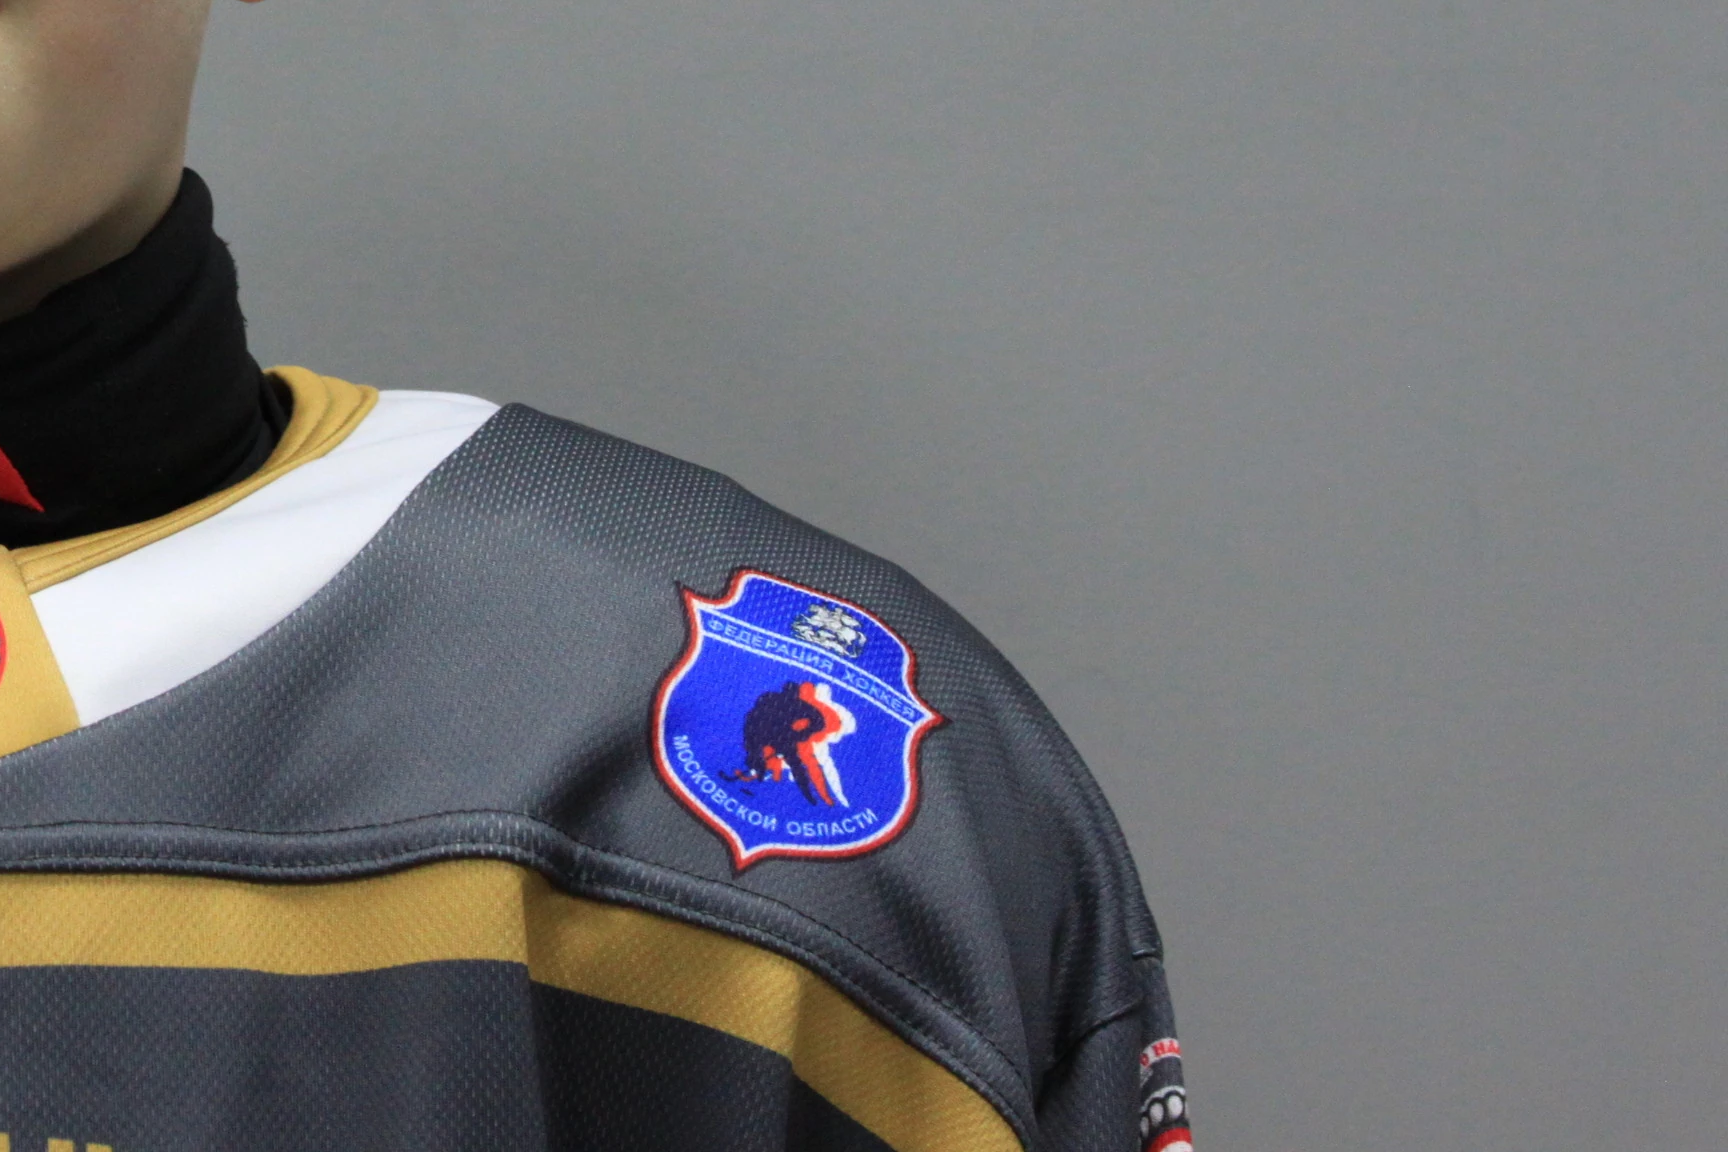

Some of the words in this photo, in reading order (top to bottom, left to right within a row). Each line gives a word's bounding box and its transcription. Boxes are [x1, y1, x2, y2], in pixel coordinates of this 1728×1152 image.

[708, 618, 834, 674] ФЕДЕРАЦИЯ
[843, 670, 917, 720] ХОККЕЯ
[786, 807, 878, 837] ОБЛАСТИ
